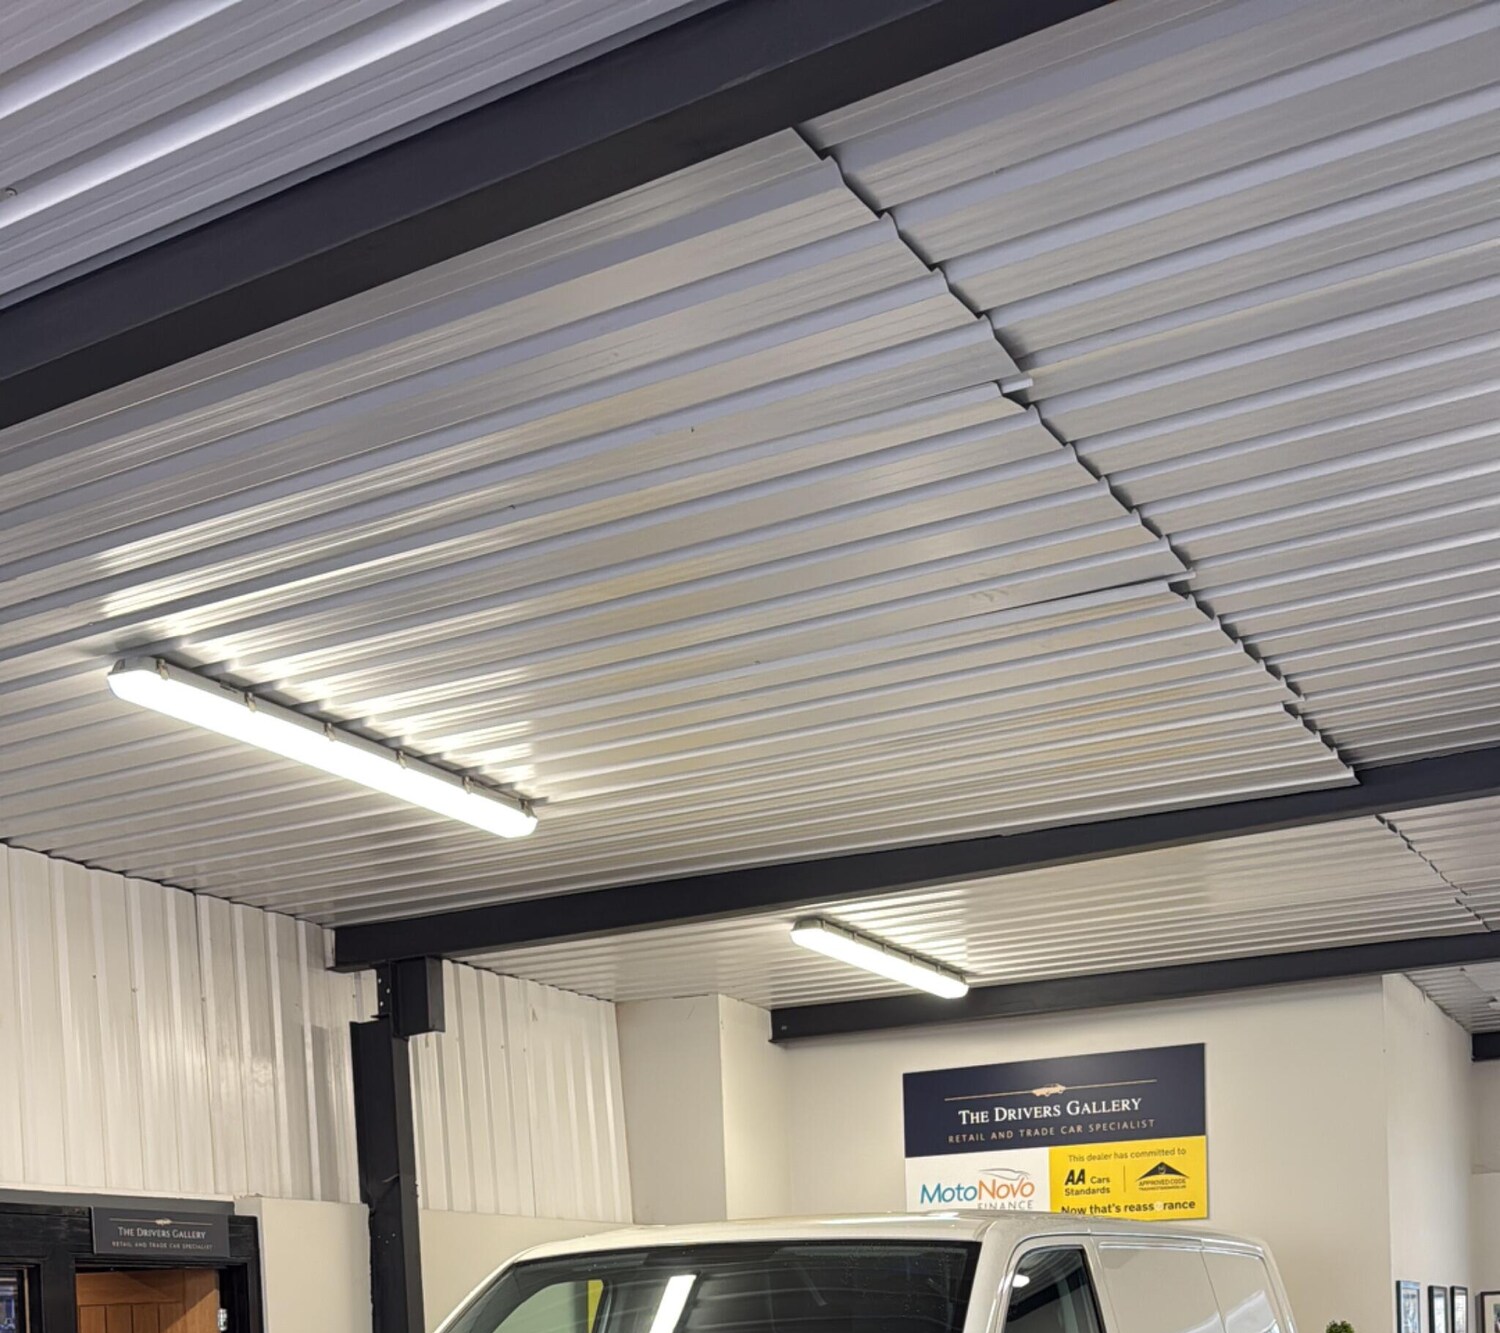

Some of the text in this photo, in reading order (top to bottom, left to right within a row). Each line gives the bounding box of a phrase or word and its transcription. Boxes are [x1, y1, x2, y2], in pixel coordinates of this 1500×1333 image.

[958, 1098, 1142, 1125] THE DRIVERS GALLERY
[948, 1119, 1156, 1144] RETAIL AND TRADE CAR SPECIALIST
[1068, 1147, 1187, 1162] This dealer has committed to
[1064, 1169, 1111, 1186] AA Cars
[1064, 1186, 1111, 1197] Standards
[977, 1200, 1034, 1210] FINANCE
[1061, 1206, 1087, 1215] Now
[1089, 1203, 1121, 1214] that's
[118, 1226, 206, 1239] THE DRIVERS GALLERY
